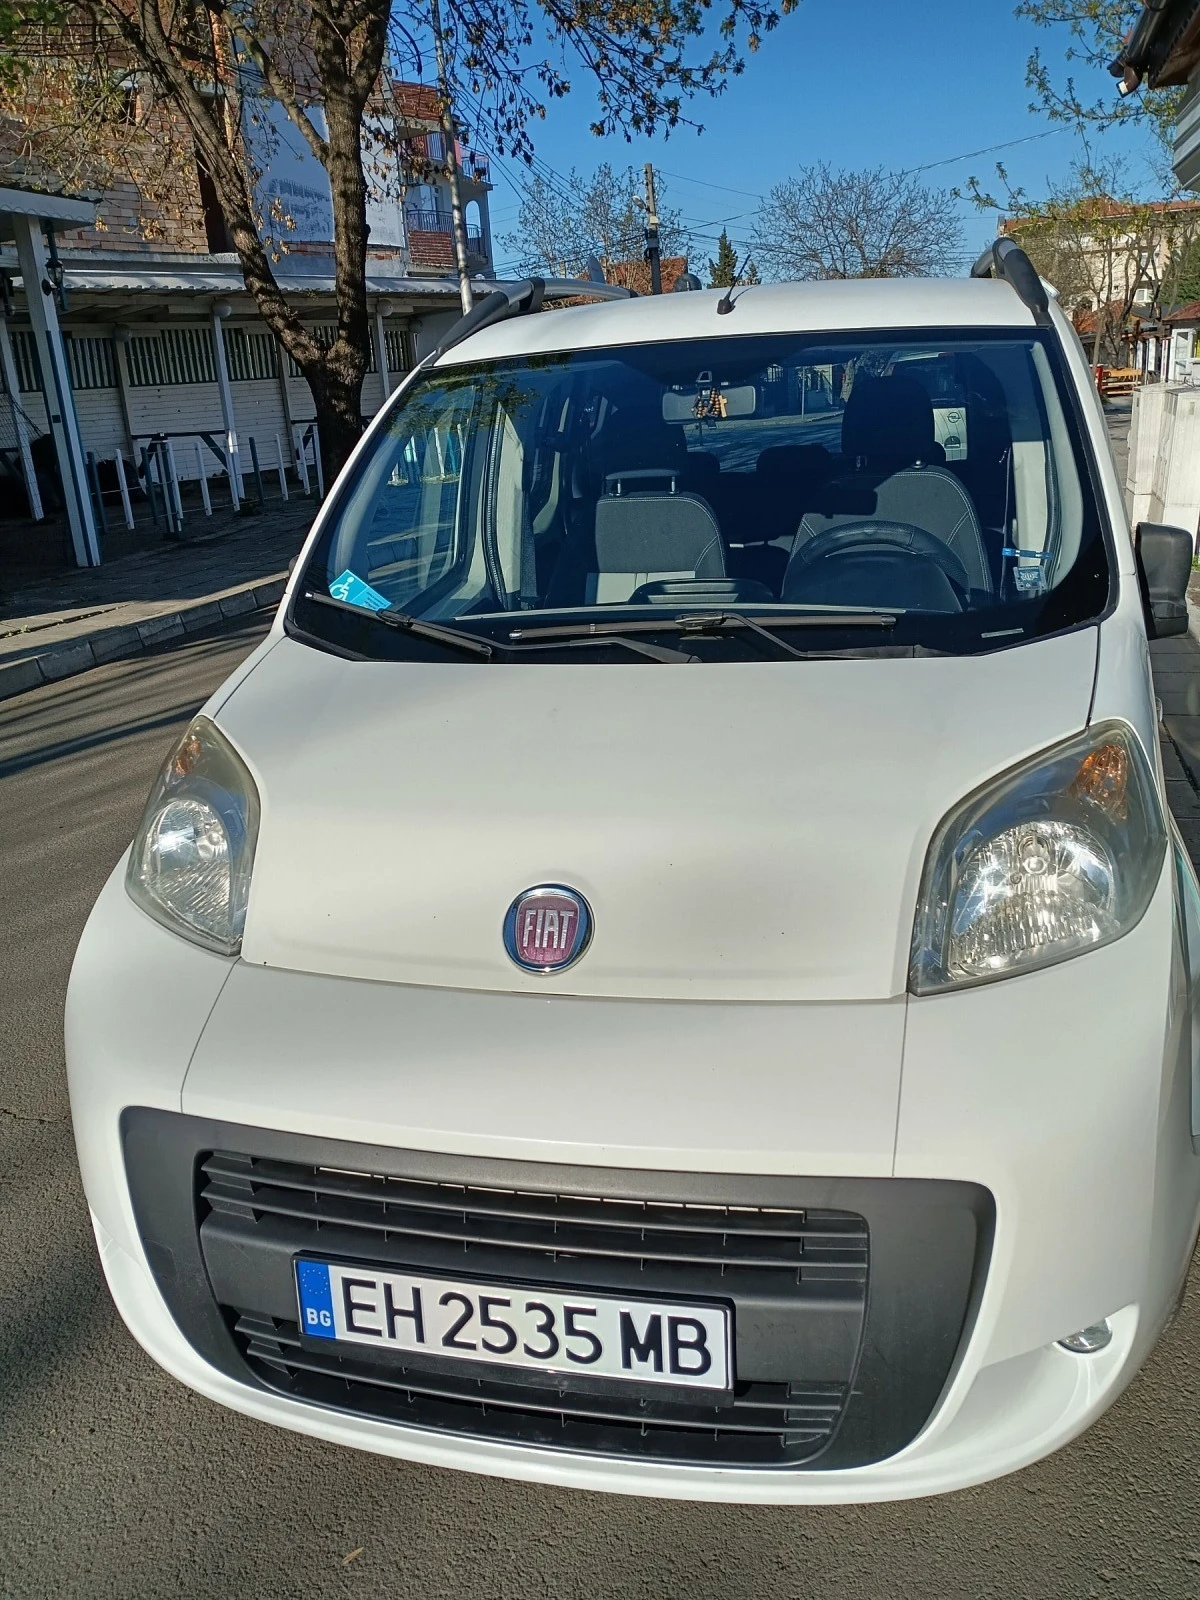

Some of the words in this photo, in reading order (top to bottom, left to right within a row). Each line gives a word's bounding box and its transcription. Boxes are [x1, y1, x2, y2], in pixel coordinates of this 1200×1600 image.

[523, 910, 574, 949] FIAT
[306, 1307, 331, 1327] BG
[341, 1276, 425, 1344] EH
[438, 1292, 603, 1365] 2535
[619, 1311, 712, 1377] MB
